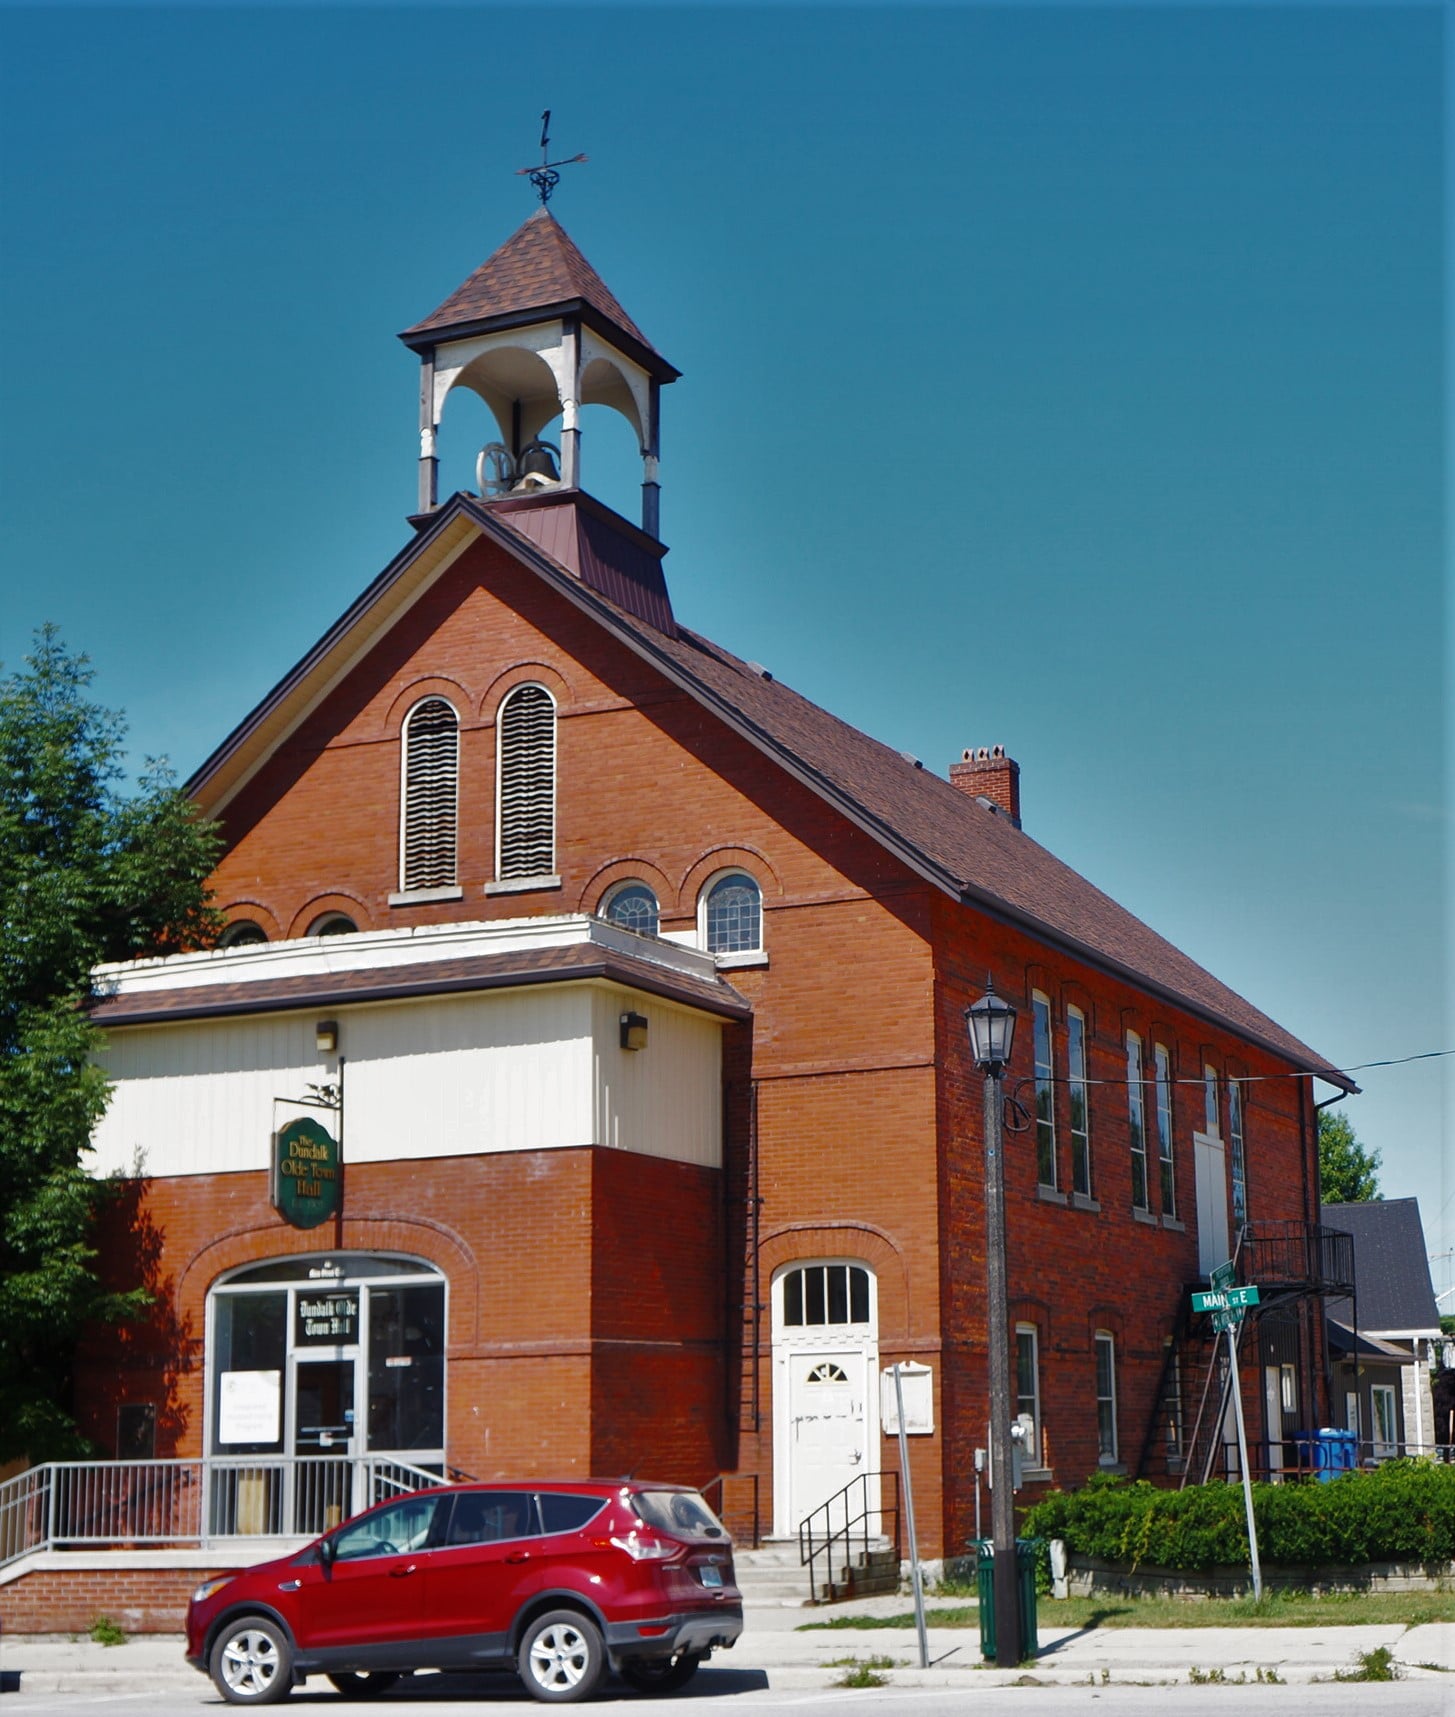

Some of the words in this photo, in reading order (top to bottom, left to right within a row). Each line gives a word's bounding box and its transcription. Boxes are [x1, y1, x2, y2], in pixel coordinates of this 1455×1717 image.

[299, 1135, 313, 1146] The
[290, 1141, 328, 1160] Dundalk
[281, 1159, 307, 1176] Olde
[311, 1163, 335, 1179] Town
[297, 1181, 320, 1197] Hall
[300, 1300, 334, 1318] Dundalk
[336, 1299, 357, 1316] Olde
[1202, 1293, 1228, 1307] MAIN
[1240, 1291, 1247, 1303] E
[305, 1318, 330, 1336] Town
[331, 1317, 351, 1335] Hall
